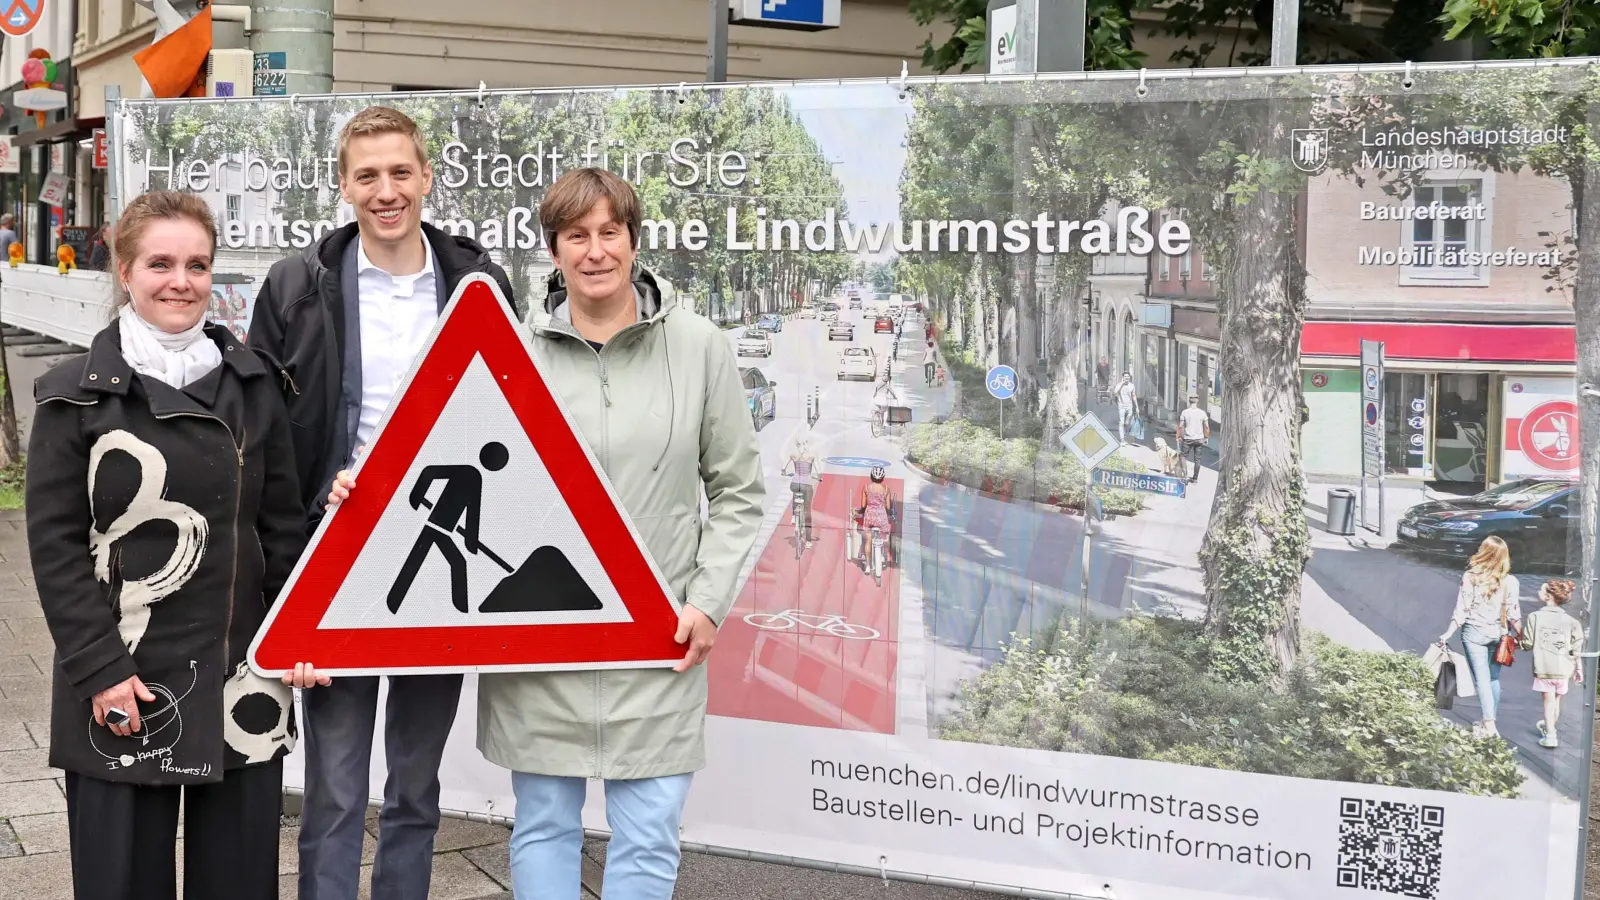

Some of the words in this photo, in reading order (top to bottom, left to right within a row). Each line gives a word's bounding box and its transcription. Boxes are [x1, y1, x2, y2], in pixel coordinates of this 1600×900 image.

[1361, 124, 1567, 147] Landeshauptstadt
[145, 149, 232, 192] Hier
[244, 146, 339, 190] baut
[441, 140, 563, 188] Stadt
[669, 137, 762, 187] Sie:
[1360, 150, 1467, 170] München
[1359, 201, 1486, 221] Baureferat
[726, 206, 1192, 256] Lindwurmstraße
[1358, 246, 1562, 268] Mobilitätsreferat
[1102, 471, 1177, 493] Ringseisstr.
[137, 746, 172, 762] happy
[159, 757, 211, 776] flowers!!
[810, 756, 1260, 826] muenchen.de/lindwurmstrasse
[812, 788, 963, 828] Baustellen-
[971, 808, 1024, 836] und
[1036, 814, 1312, 871] Projektinformation
